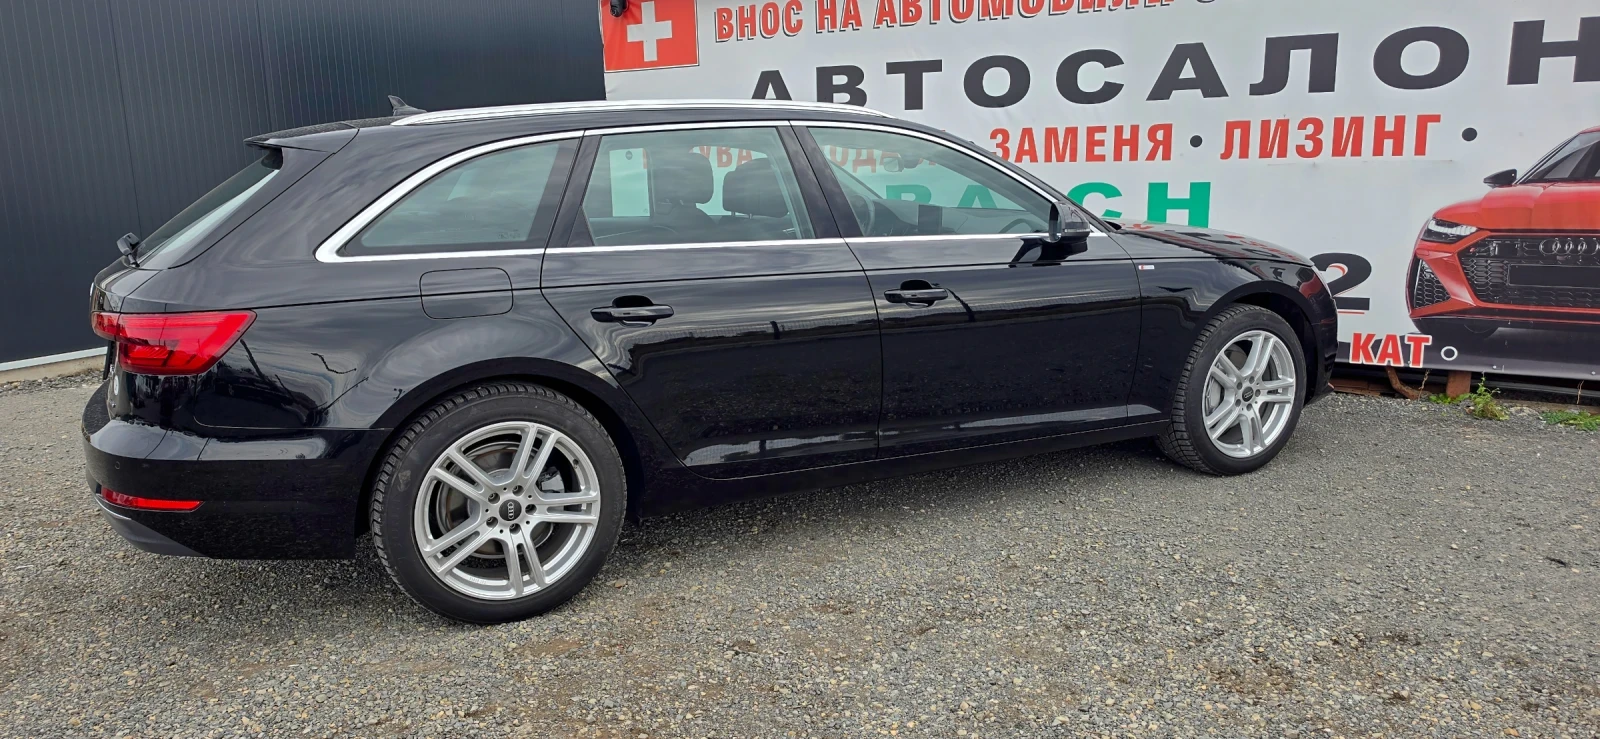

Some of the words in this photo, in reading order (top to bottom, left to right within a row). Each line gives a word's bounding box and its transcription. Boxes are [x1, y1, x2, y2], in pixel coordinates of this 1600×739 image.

[714, 0, 804, 42] ВНОС
[816, 0, 863, 33] НА
[751, 16, 1600, 111] АВТОСАЛОН
[989, 123, 1173, 163] ЗАМЕНЯ
[1220, 114, 1441, 160] ЛИЗИНГ
[1350, 332, 1432, 368] КАТ
